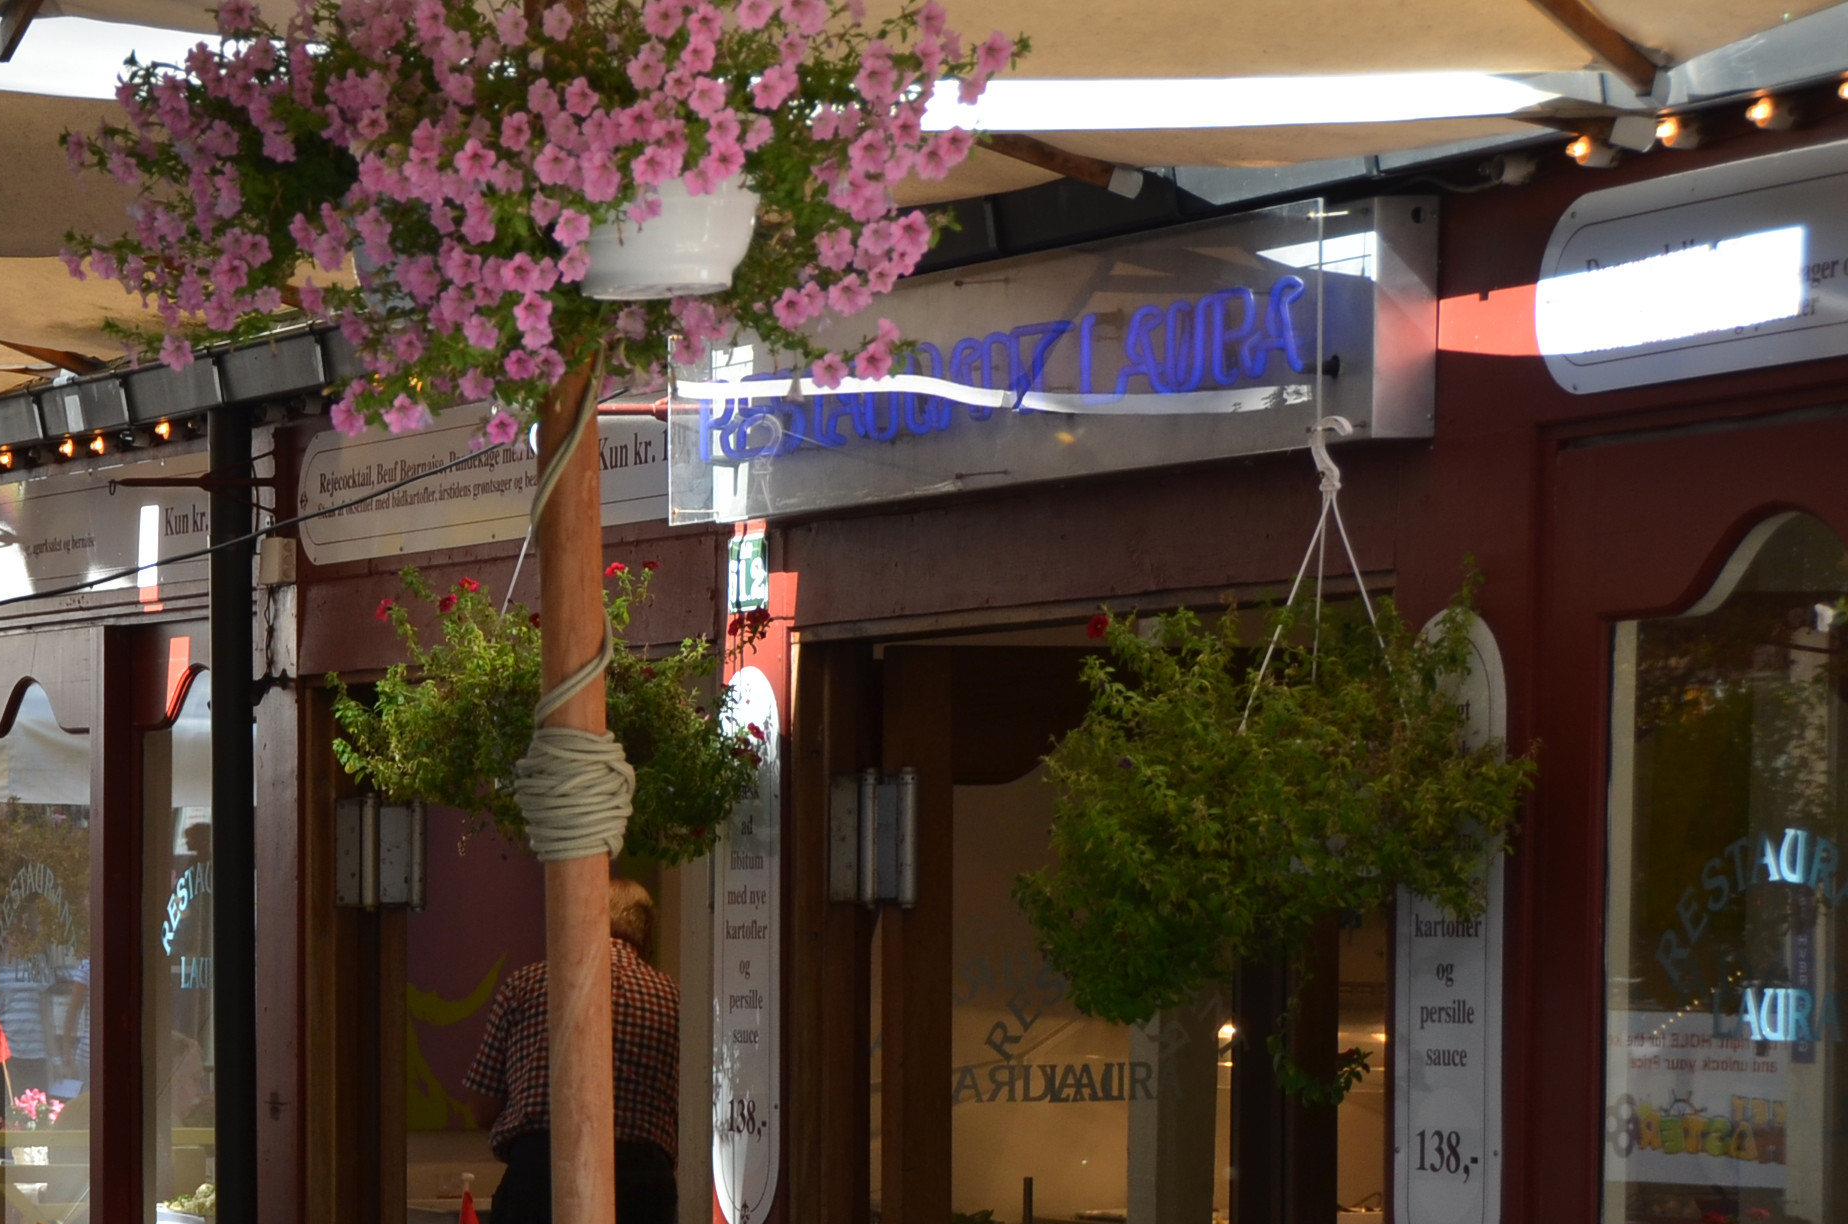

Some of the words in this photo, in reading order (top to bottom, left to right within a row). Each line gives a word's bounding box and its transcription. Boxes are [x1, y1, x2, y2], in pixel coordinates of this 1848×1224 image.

[598, 436, 629, 471] Kun
[633, 432, 656, 466] kr.
[319, 465, 375, 497] Rejecocktail,
[376, 460, 399, 485] Beuf
[374, 493, 390, 511] med
[472, 476, 513, 498] grøntsager
[514, 478, 523, 493] og
[163, 506, 189, 537] Kun
[741, 814, 753, 835] ad
[730, 850, 764, 871] libitum
[161, 861, 213, 957] RESTAU
[727, 884, 747, 906] med
[749, 888, 767, 910] nye
[1656, 828, 1848, 992] RESTAUR
[725, 919, 768, 940] kartofler
[180, 956, 213, 989] LAU
[739, 959, 751, 979] og
[1436, 962, 1454, 987] og
[729, 989, 764, 1014] persille
[1420, 999, 1475, 1031] persille
[732, 1027, 759, 1044] sauce
[1425, 1048, 1468, 1067] sauce
[1415, 1128, 1479, 1184] 138,-
